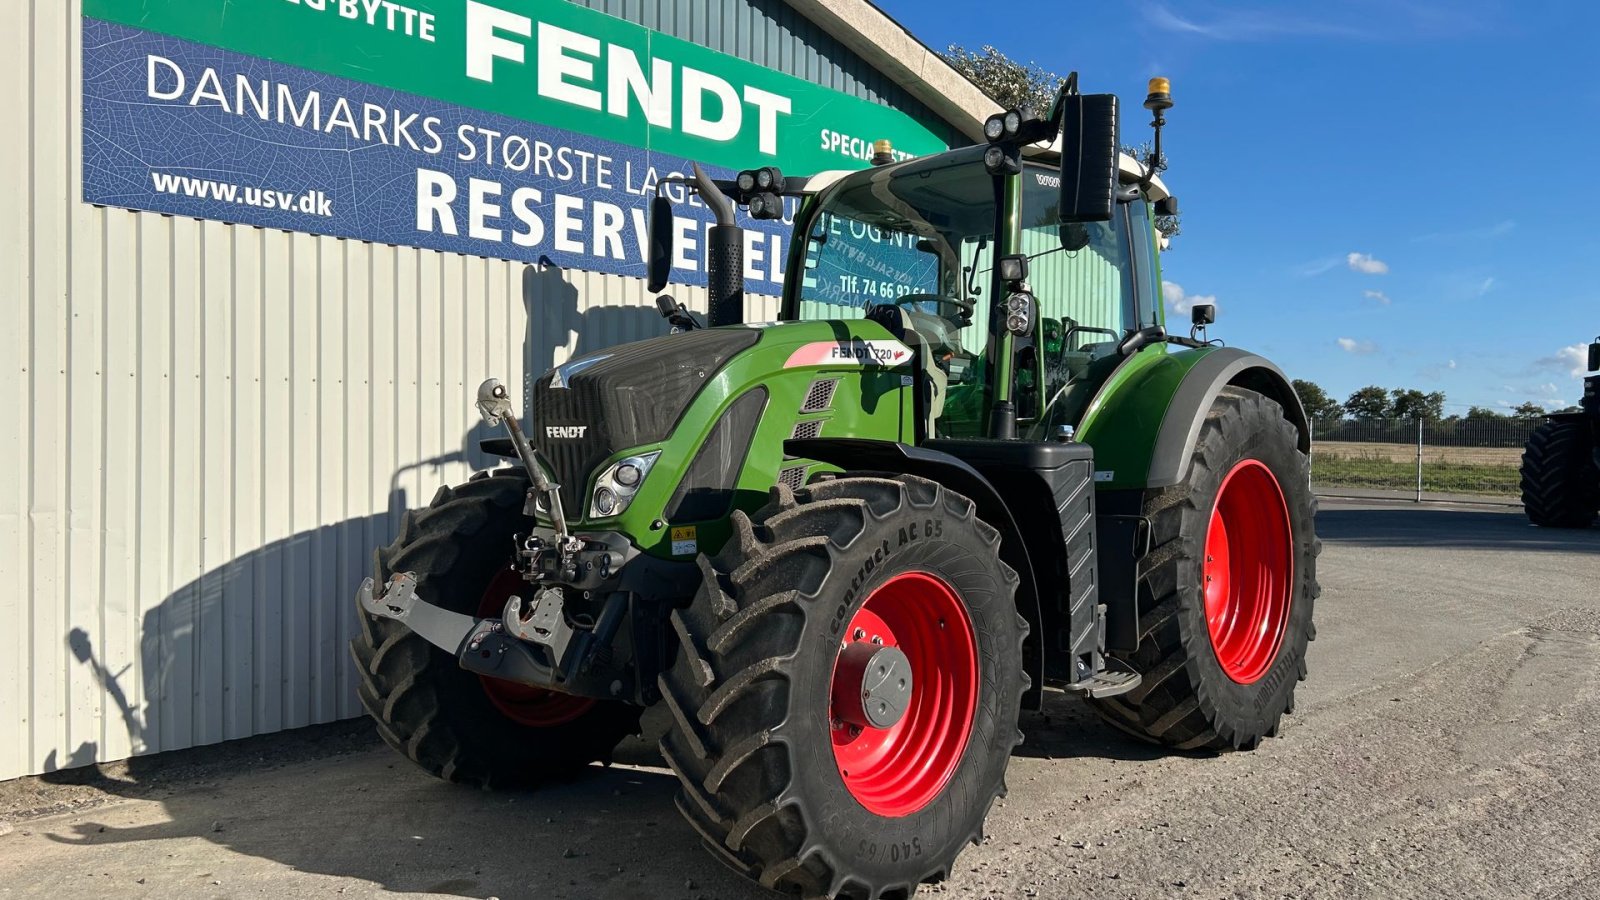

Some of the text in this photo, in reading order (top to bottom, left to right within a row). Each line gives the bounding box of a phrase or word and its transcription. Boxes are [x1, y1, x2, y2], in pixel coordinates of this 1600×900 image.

[466, 0, 792, 156] FENDT
[147, 54, 443, 154] DANMARKS
[457, 124, 612, 189] STØRSTE
[625, 160, 710, 209] LAGE
[821, 129, 918, 162] SPECIAST
[151, 172, 332, 217] www.usv.dk
[840, 275, 860, 294] Tlf.
[862, 278, 877, 297] 74
[880, 281, 894, 299] 66
[832, 347, 869, 359] FENDT
[873, 349, 892, 360] 720
[545, 426, 587, 438] FENDT
[829, 519, 943, 635] contract AC 65
